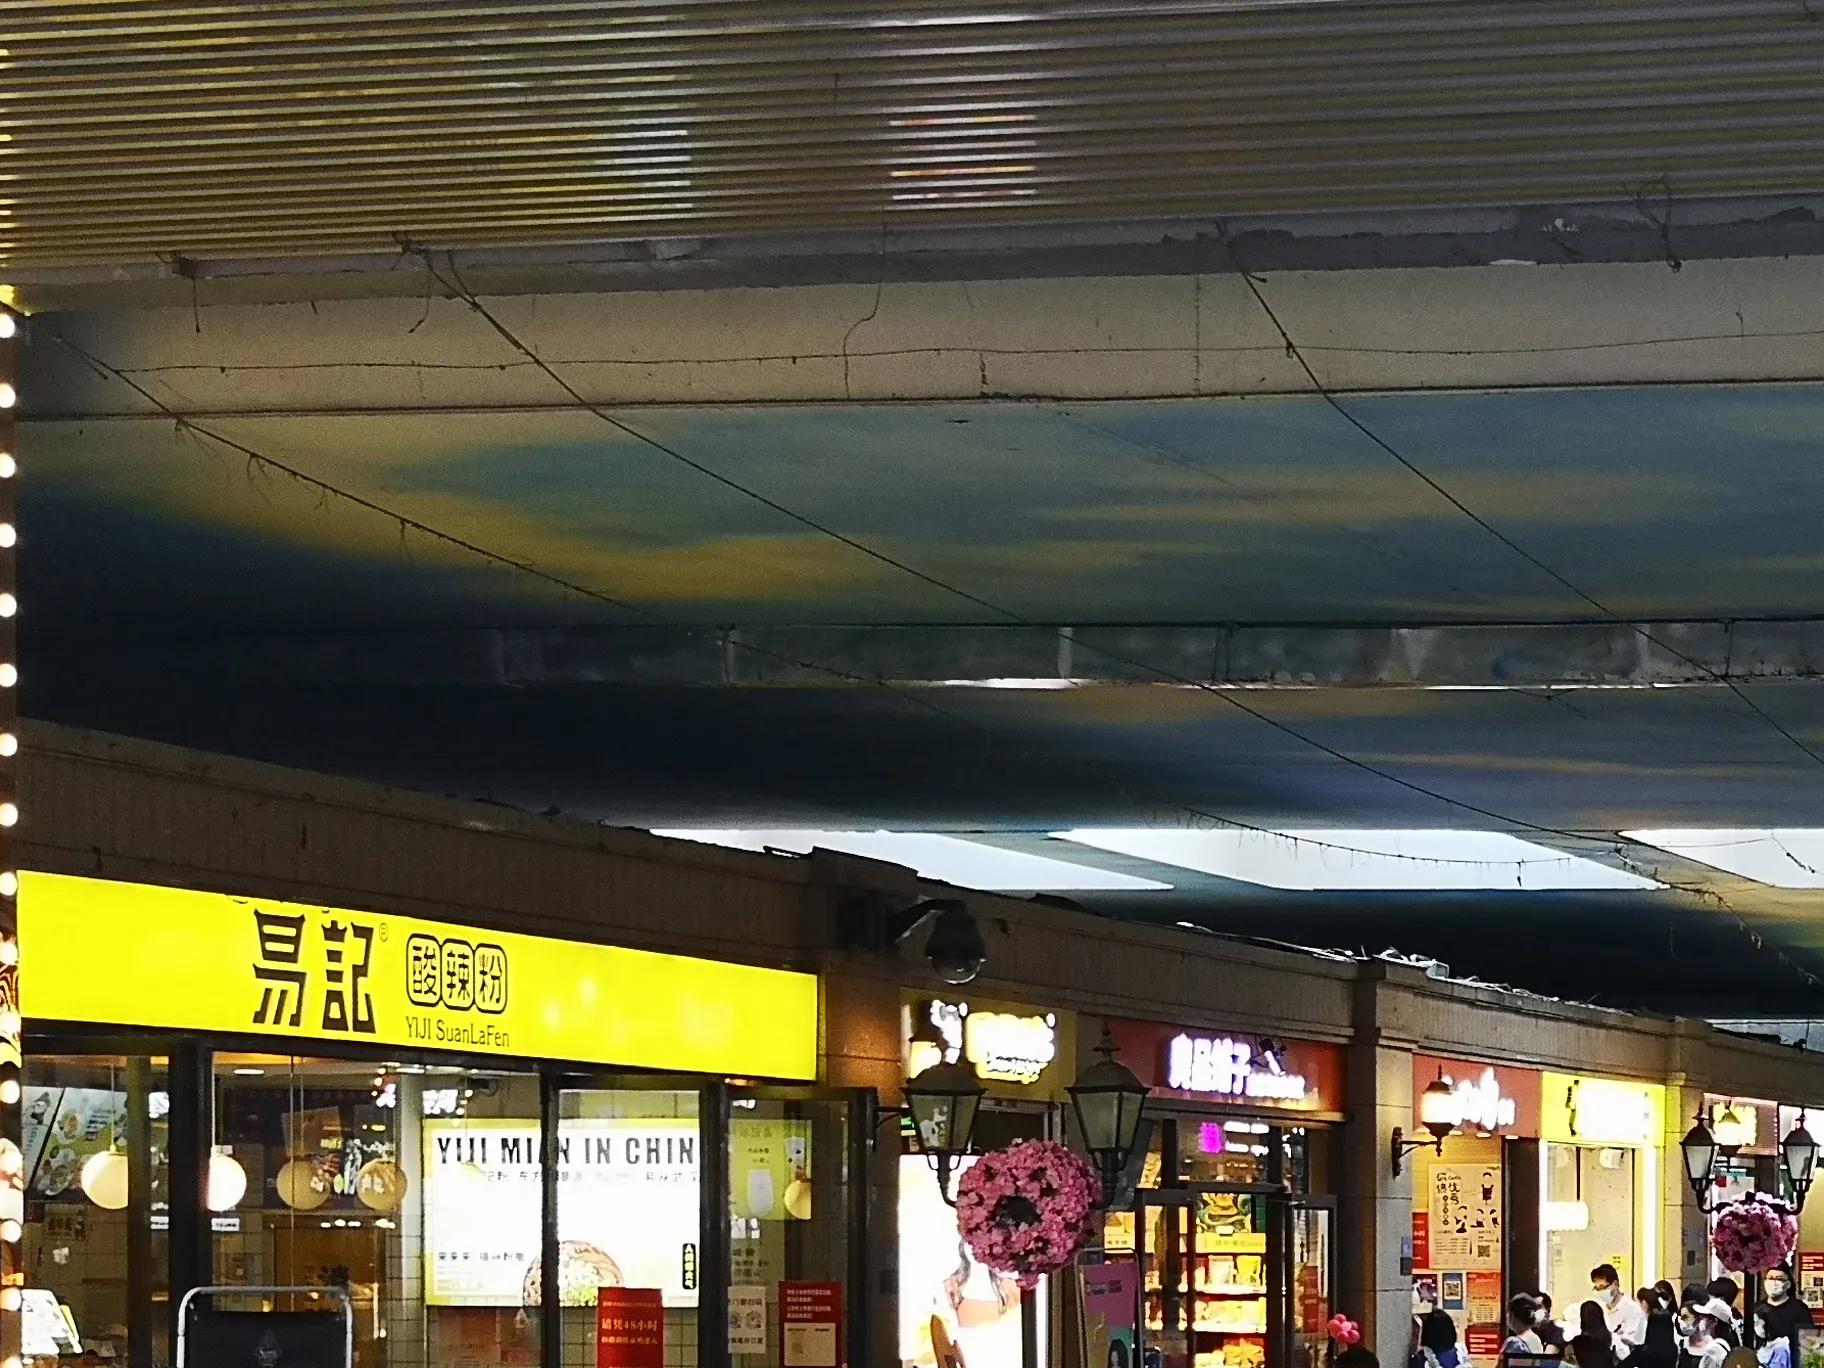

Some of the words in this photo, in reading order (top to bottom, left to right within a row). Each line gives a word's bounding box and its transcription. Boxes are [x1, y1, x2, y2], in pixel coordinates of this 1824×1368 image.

[253, 908, 376, 1033] 易記
[412, 945, 503, 1004] 酸辣粉
[406, 1016, 431, 1040] YIJI
[436, 1020, 510, 1048] SuanLaFen
[437, 1137, 487, 1165] YIJI
[501, 1137, 570, 1165] MIN
[584, 1137, 612, 1165] IN
